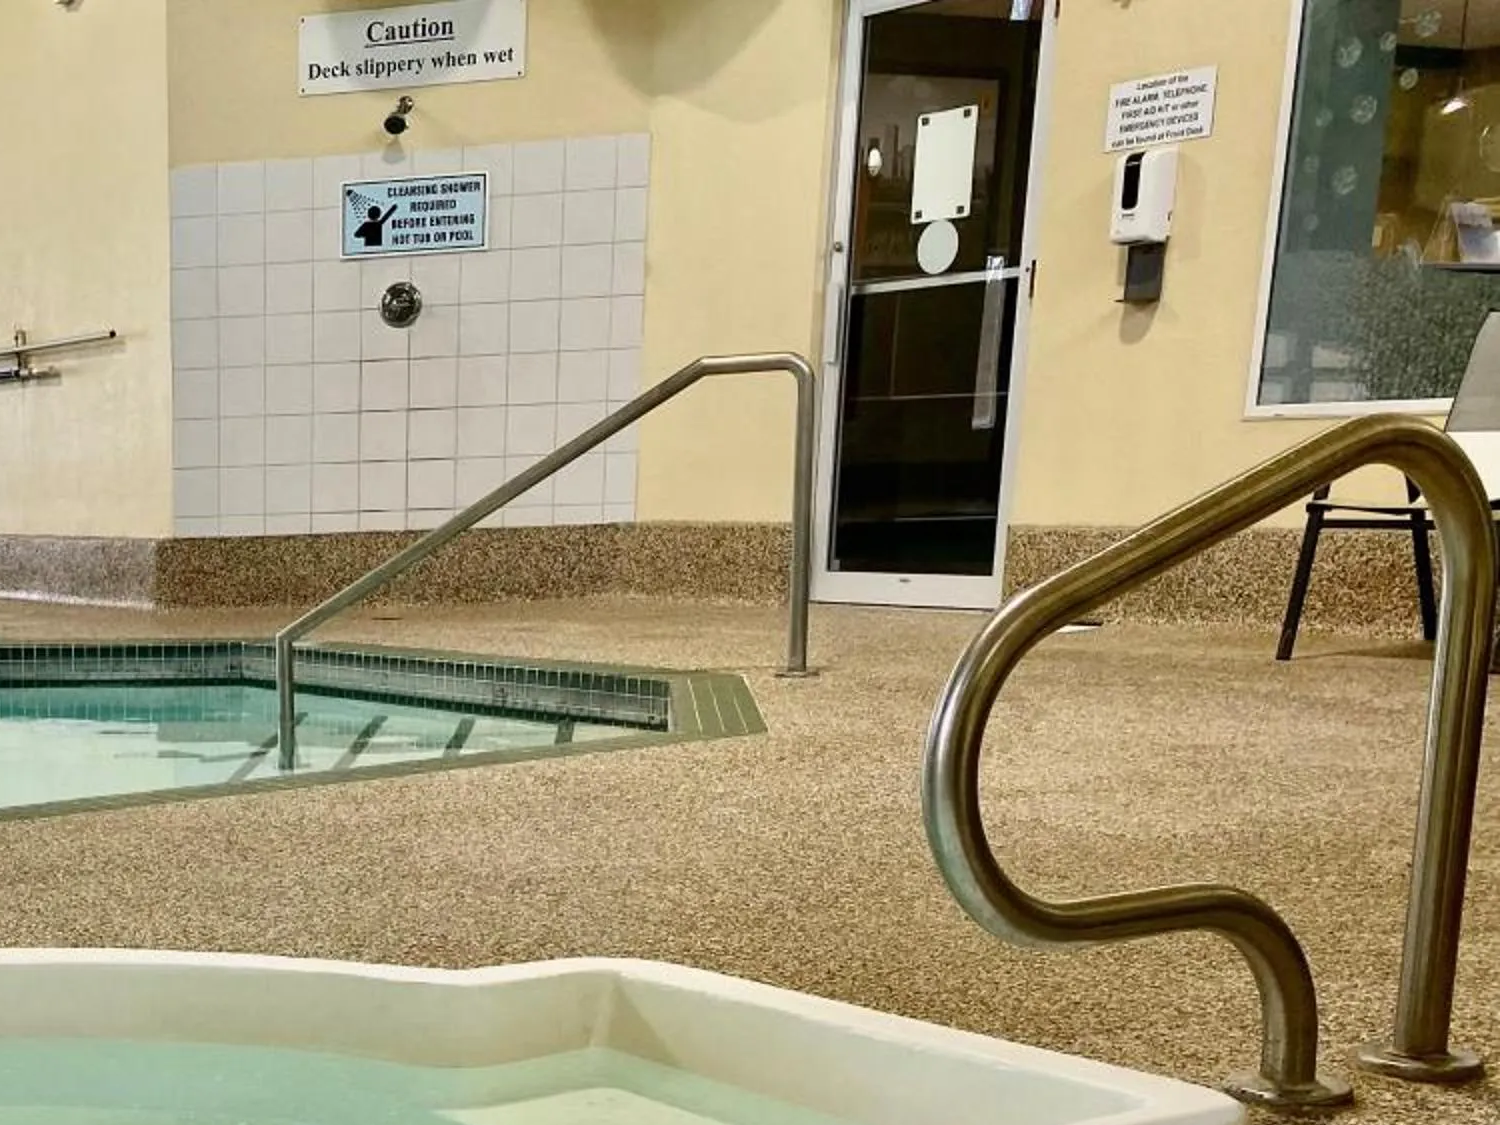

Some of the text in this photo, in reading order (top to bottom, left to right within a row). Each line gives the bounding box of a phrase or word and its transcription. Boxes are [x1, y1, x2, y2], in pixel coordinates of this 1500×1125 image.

[366, 18, 454, 44] Caution
[308, 47, 514, 80] Deck slippery when wet
[1168, 76, 1177, 85] of
[1178, 75, 1189, 83] the
[1115, 97, 1131, 108] FIRE
[1121, 107, 1143, 119] FIRST
[1144, 106, 1156, 115] AID
[1135, 133, 1157, 144] found
[387, 181, 481, 198] CLEANSING SHOWER
[410, 199, 457, 213] REQUIRED
[391, 213, 475, 229] BEFORE ENTERING
[391, 229, 474, 245] HOT TUB OR POOL
